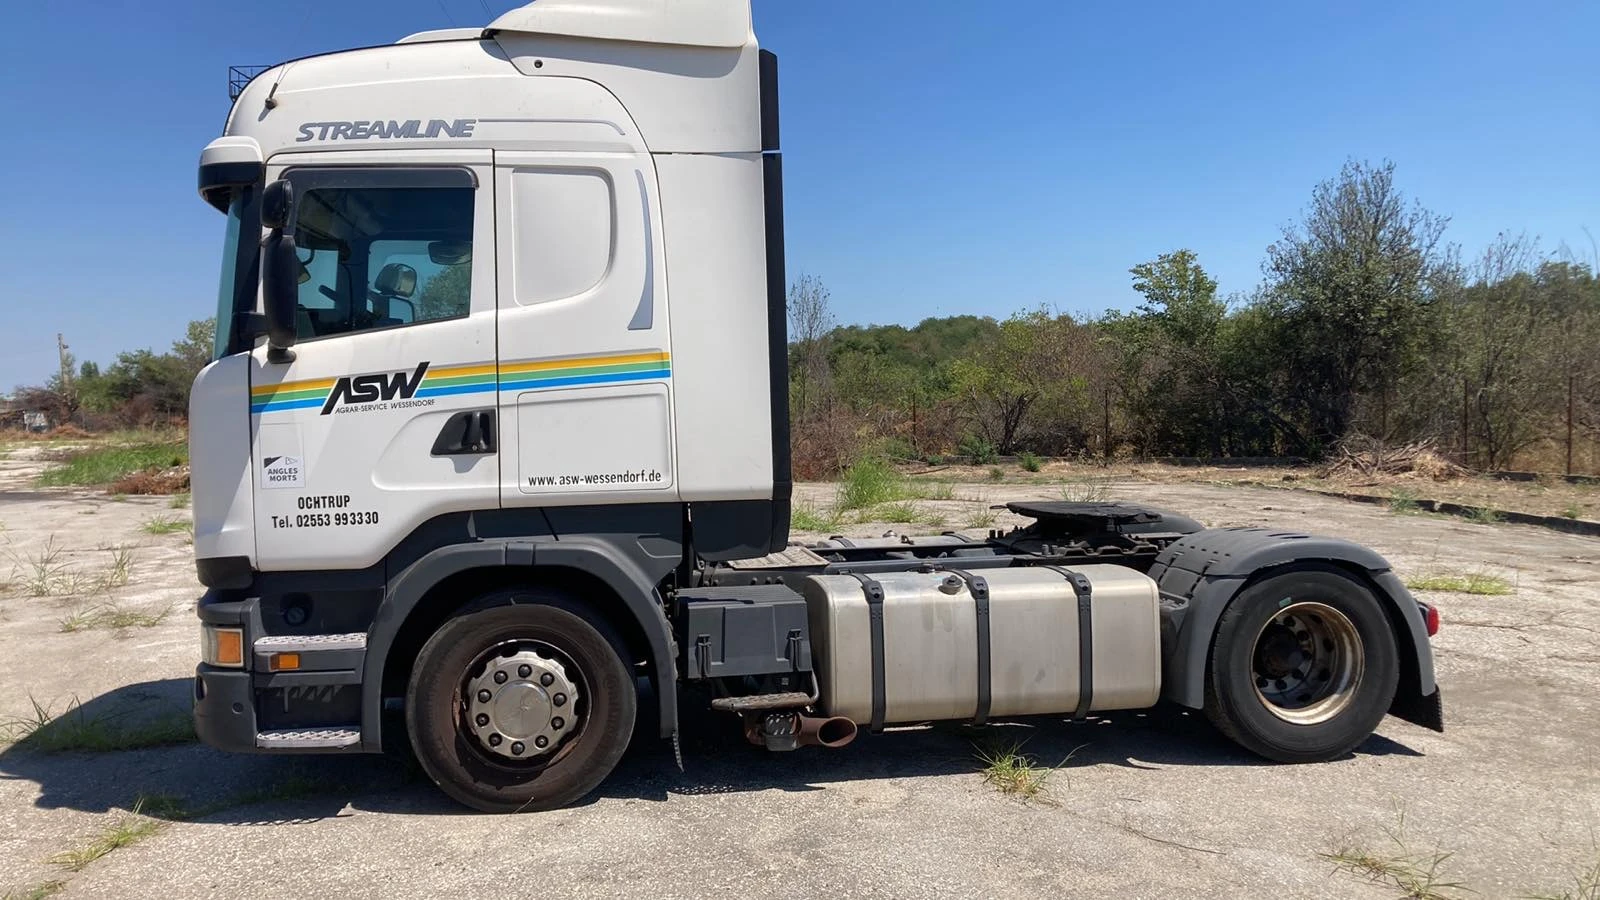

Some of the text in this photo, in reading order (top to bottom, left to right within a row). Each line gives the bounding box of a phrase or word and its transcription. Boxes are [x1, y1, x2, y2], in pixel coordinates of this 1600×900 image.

[296, 119, 476, 142] STREAMLINE
[320, 361, 430, 415] ASW
[335, 399, 435, 414] AGRAR-SERVICE WESSENDORF
[267, 467, 298, 475] ANGLES
[528, 469, 662, 486] www.asw-wessendorf.de
[297, 495, 350, 509] OCHTRUP
[272, 511, 379, 528] Tel. 02553 993330
